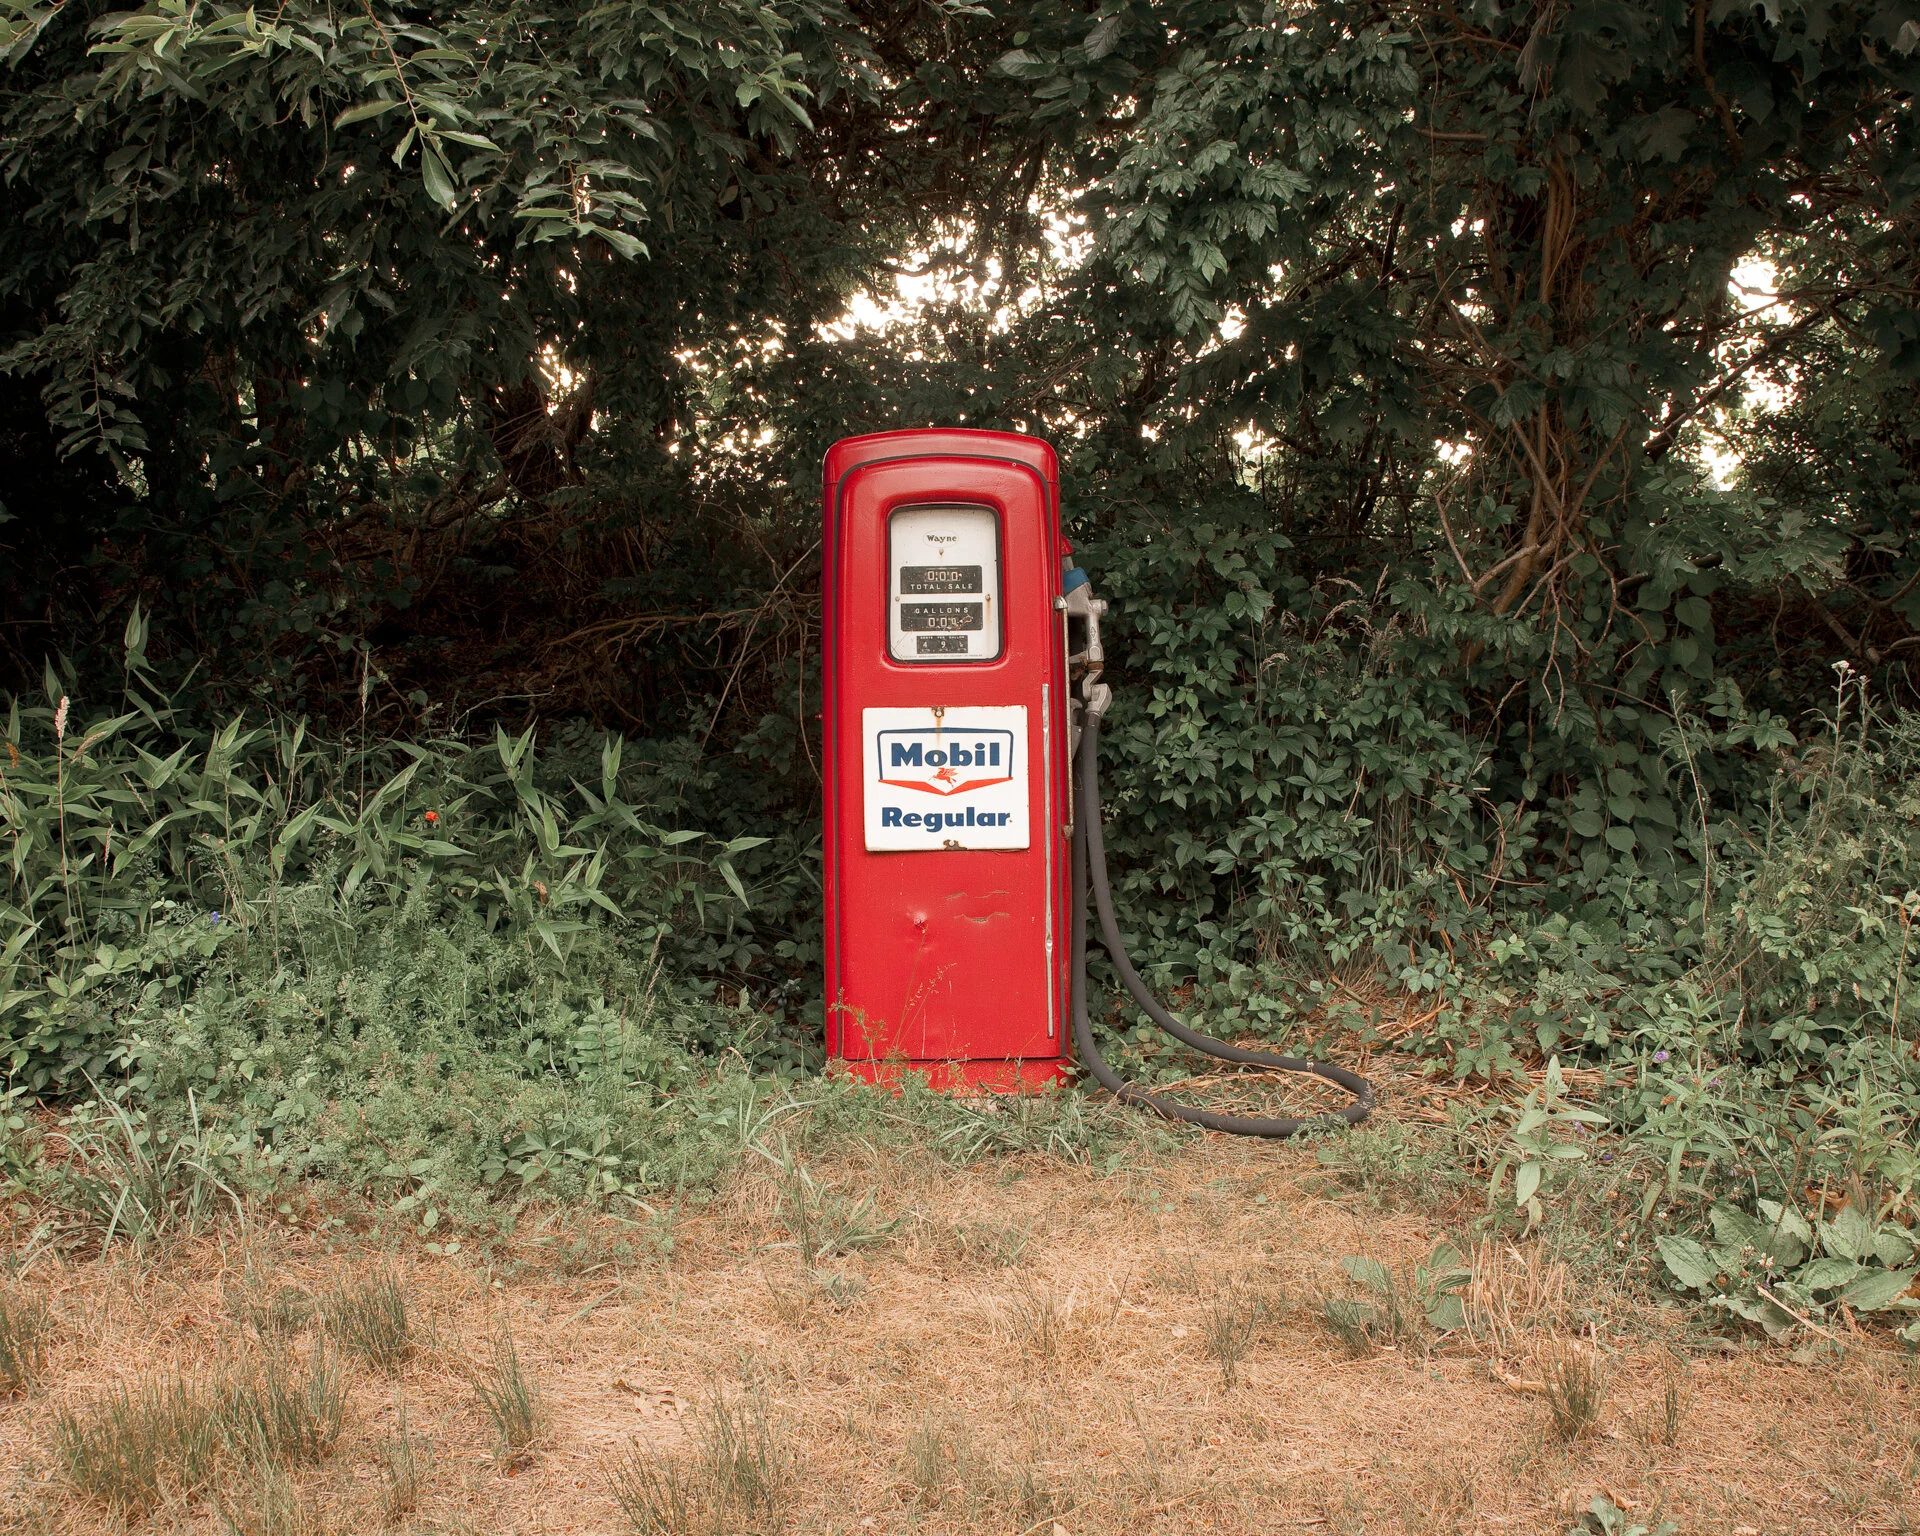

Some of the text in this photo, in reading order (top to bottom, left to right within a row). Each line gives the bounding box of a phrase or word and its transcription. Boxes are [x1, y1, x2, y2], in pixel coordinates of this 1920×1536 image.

[926, 534, 957, 544] Wayne
[940, 640, 946, 648] 9
[891, 742, 1000, 767] Mobil
[881, 807, 1011, 833] Regular
